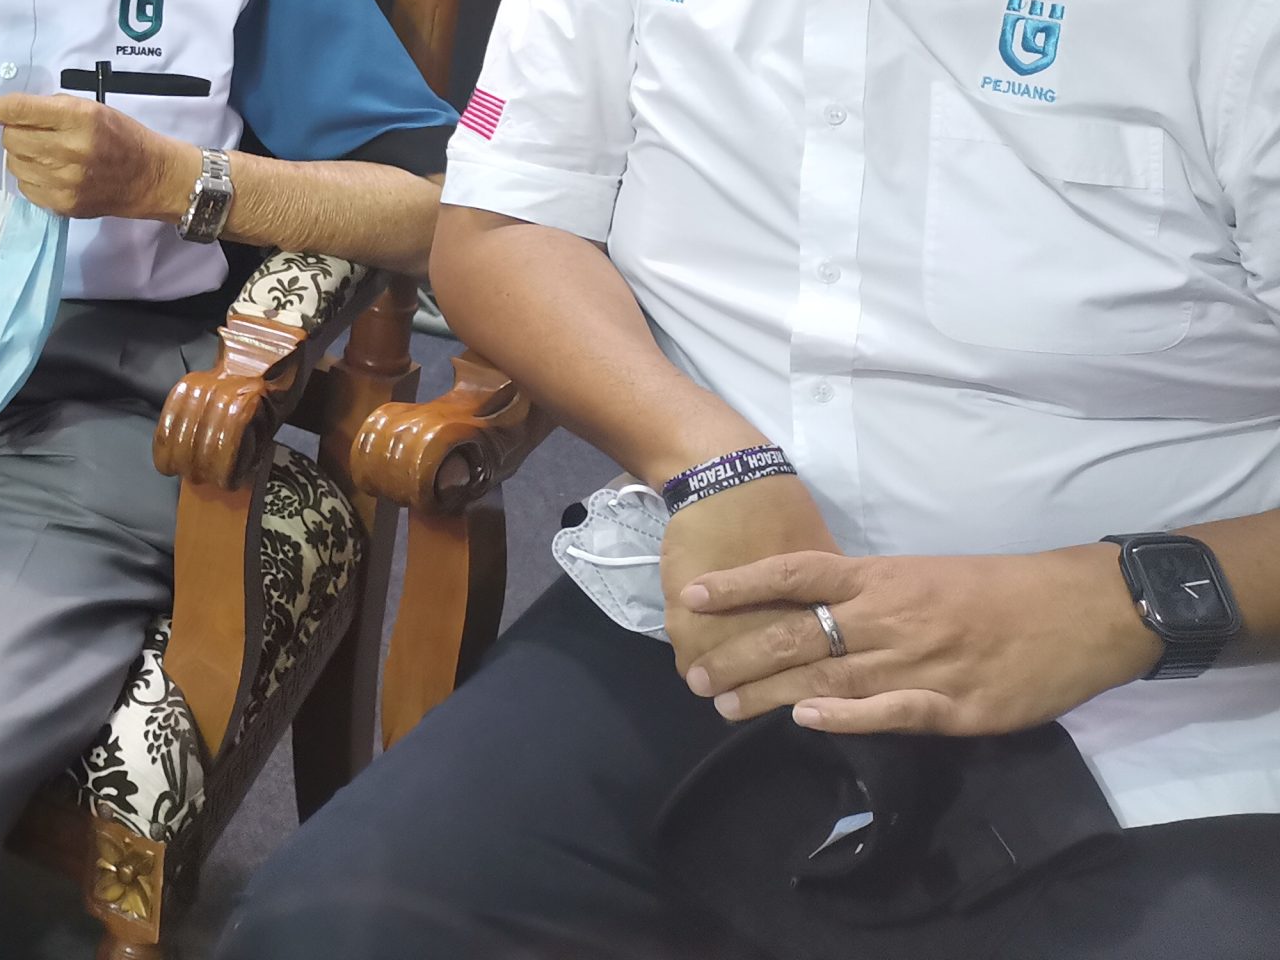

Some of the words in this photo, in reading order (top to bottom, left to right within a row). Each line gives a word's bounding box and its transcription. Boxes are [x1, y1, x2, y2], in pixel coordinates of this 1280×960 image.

[116, 45, 163, 57] PEJUANG
[980, 75, 1057, 103] PEJUANG
[688, 462, 735, 492] TEACH
